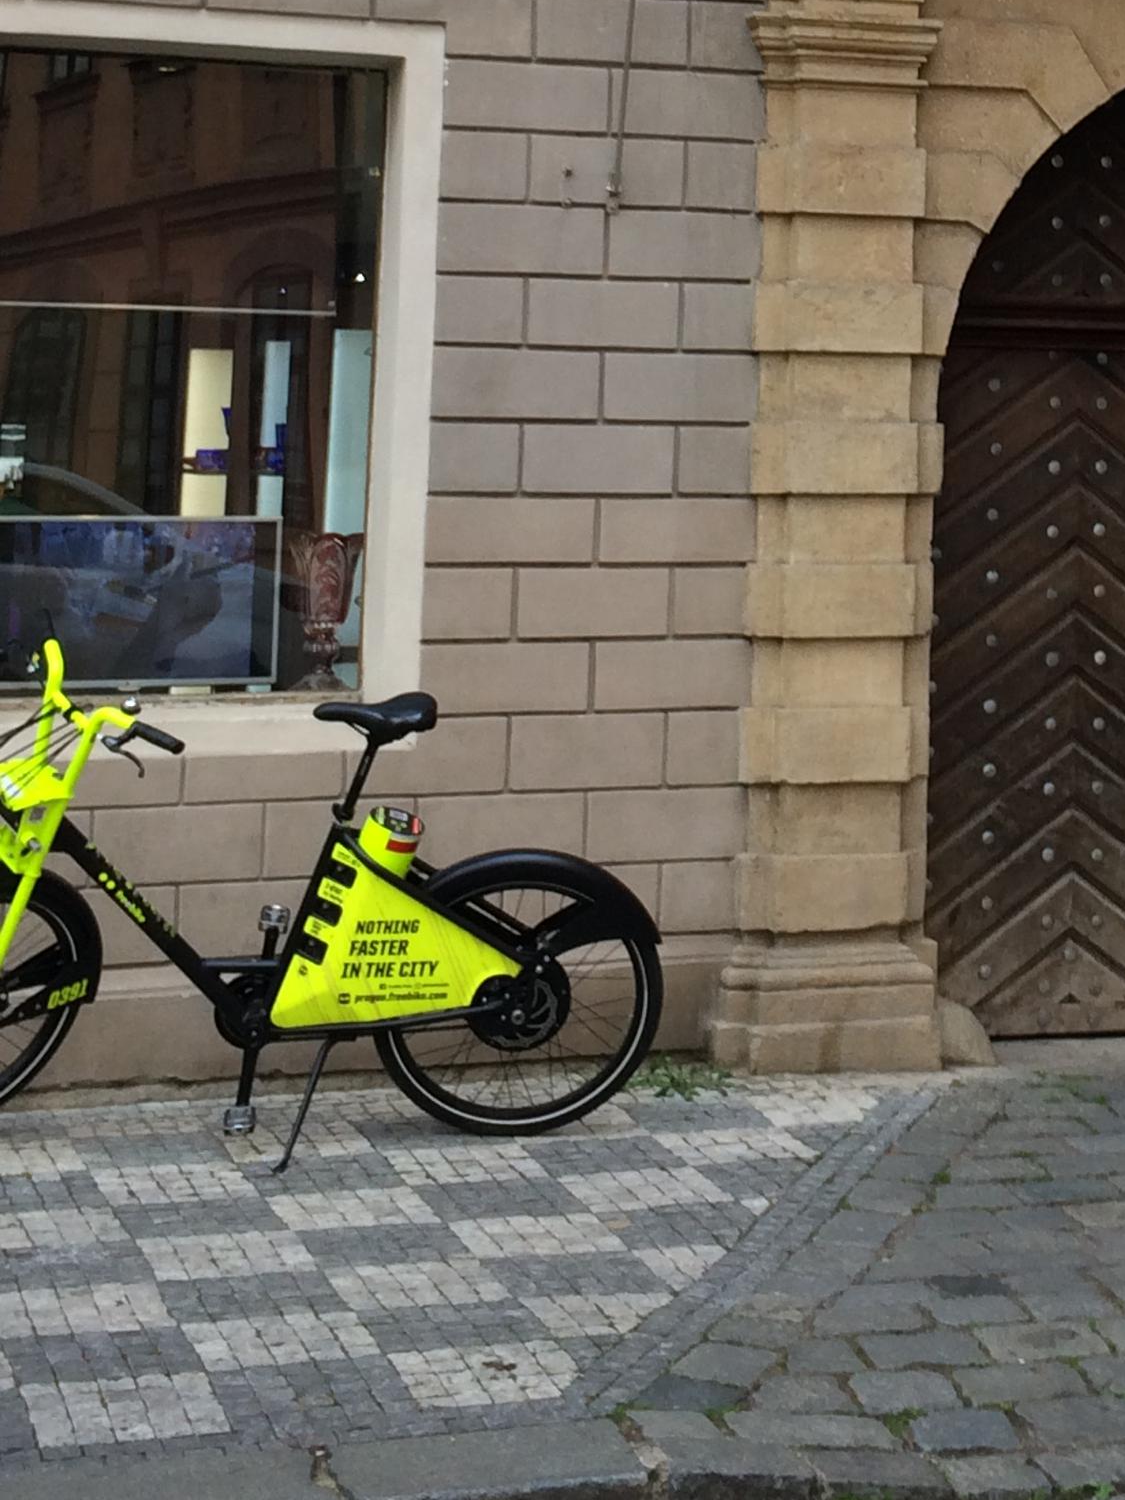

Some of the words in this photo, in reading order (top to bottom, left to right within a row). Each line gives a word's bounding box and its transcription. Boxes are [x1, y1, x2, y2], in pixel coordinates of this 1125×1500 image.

[355, 919, 420, 935] NOTHING
[349, 940, 409, 956] FASTER
[341, 962, 361, 979] IN
[366, 962, 396, 978] THE
[398, 960, 439, 977] CITY
[47, 978, 89, 1010] 0391
